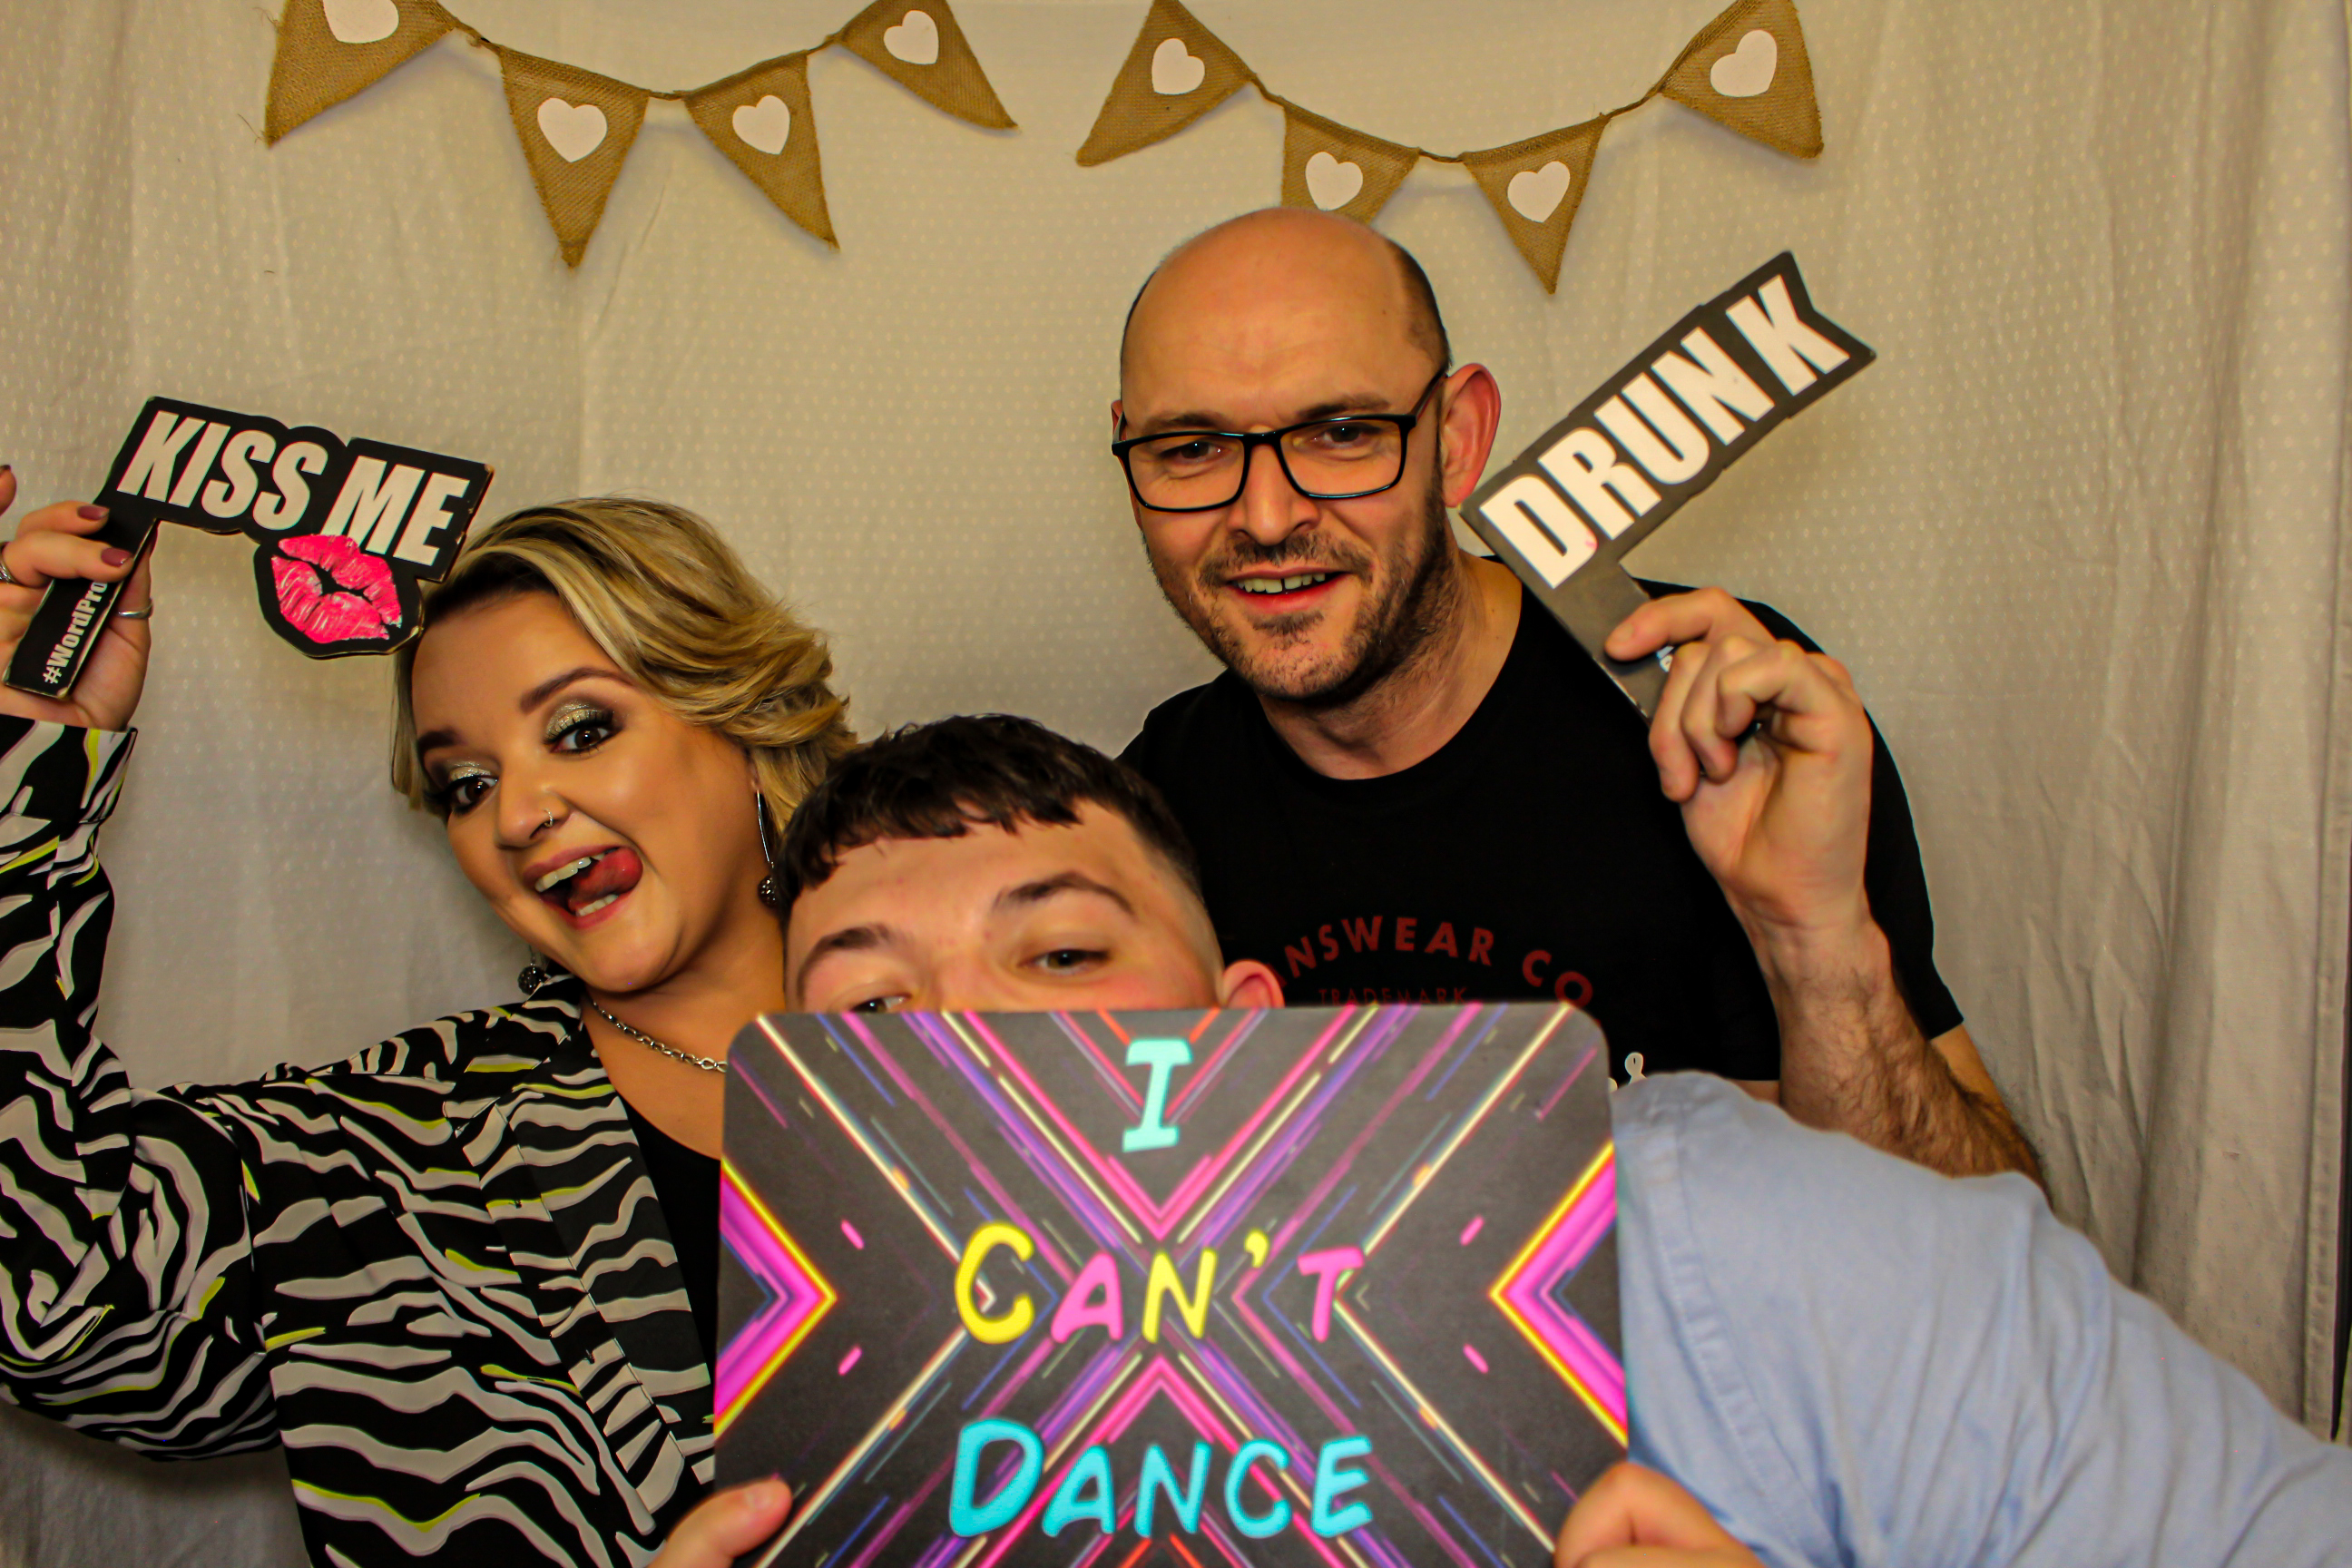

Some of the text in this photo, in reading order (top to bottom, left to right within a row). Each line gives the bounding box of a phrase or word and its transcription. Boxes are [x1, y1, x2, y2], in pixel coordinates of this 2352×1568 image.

[116, 410, 470, 566] KISS ME
[1478, 274, 1850, 589] DRUNK
[1268, 916, 1494, 987] NSWEAR
[1318, 986, 1468, 1006] TRADEMARK
[1122, 1039, 1192, 1152] I
[955, 1221, 1363, 1344] CAN'T
[949, 1419, 1372, 1538] DANCE
